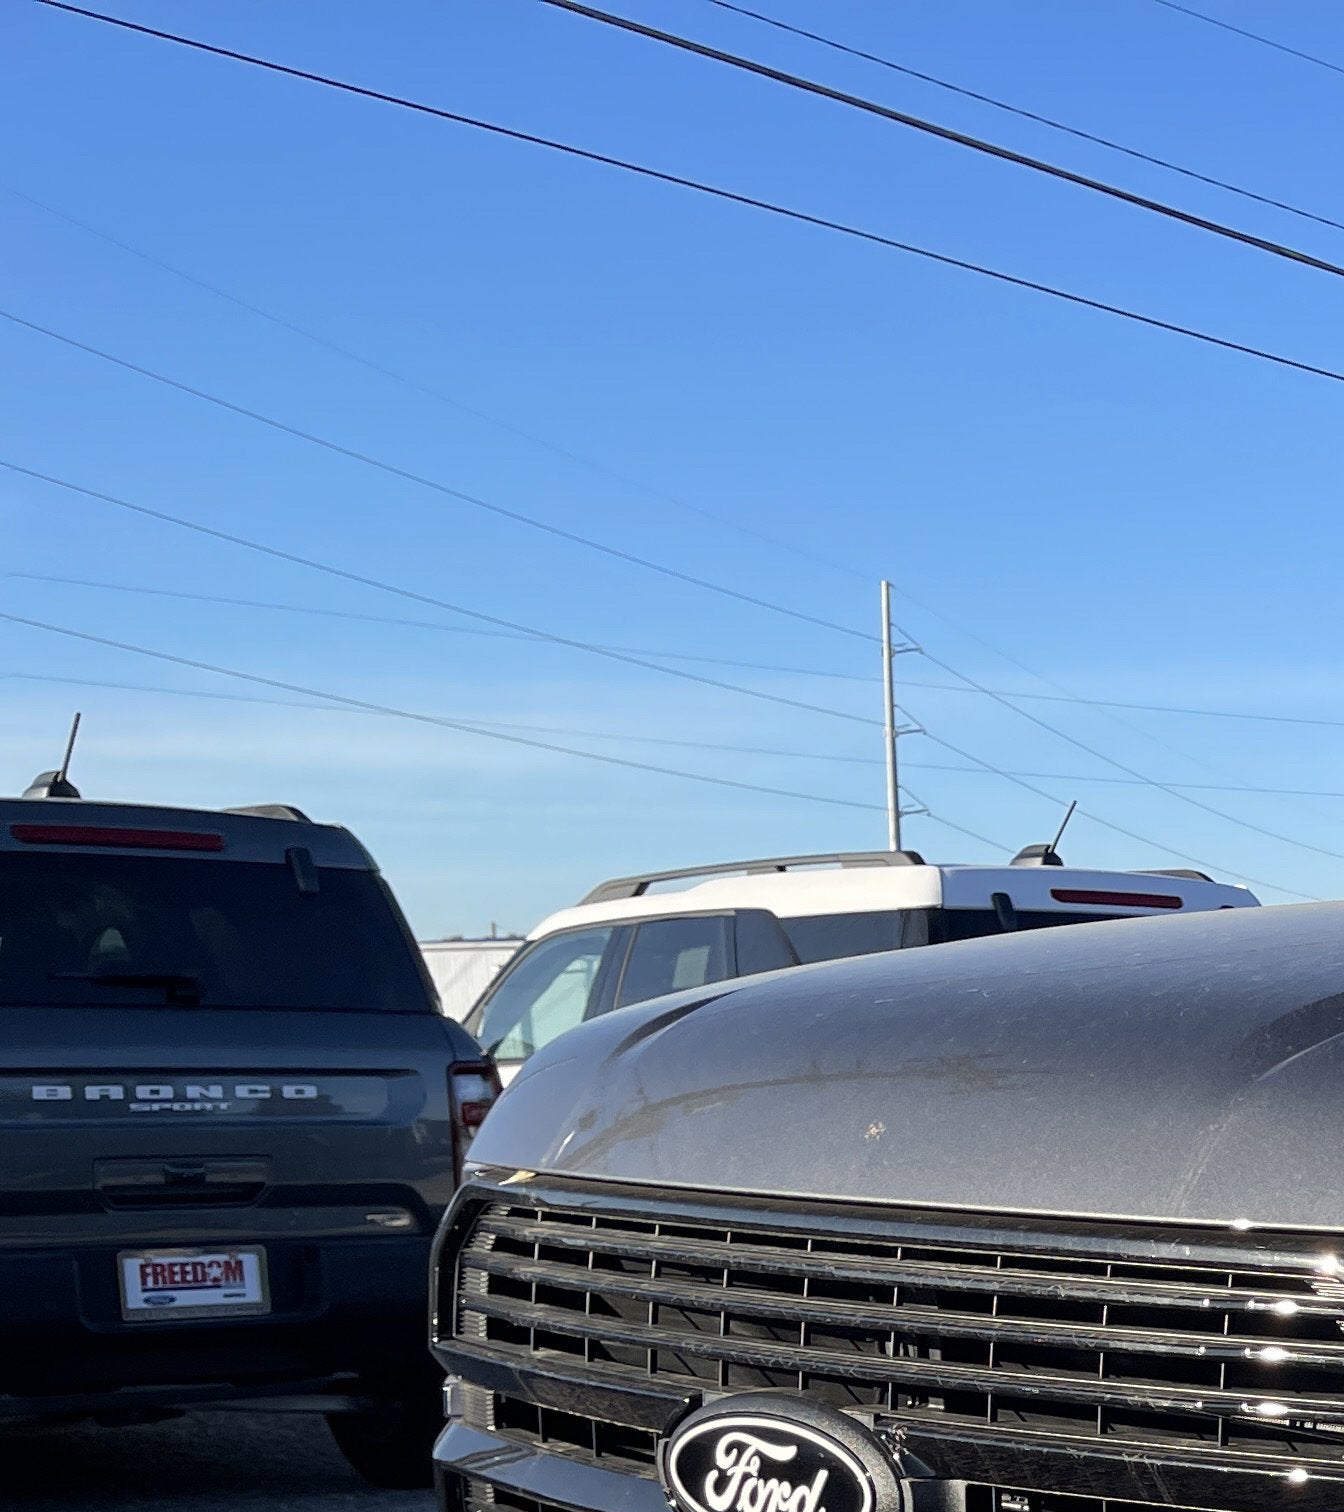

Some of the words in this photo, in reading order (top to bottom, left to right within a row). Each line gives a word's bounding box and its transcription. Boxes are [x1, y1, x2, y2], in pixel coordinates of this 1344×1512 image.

[31, 1084, 318, 1100] BRONCO
[129, 1101, 230, 1112] SPORT
[140, 1260, 244, 1286] FREEDOM
